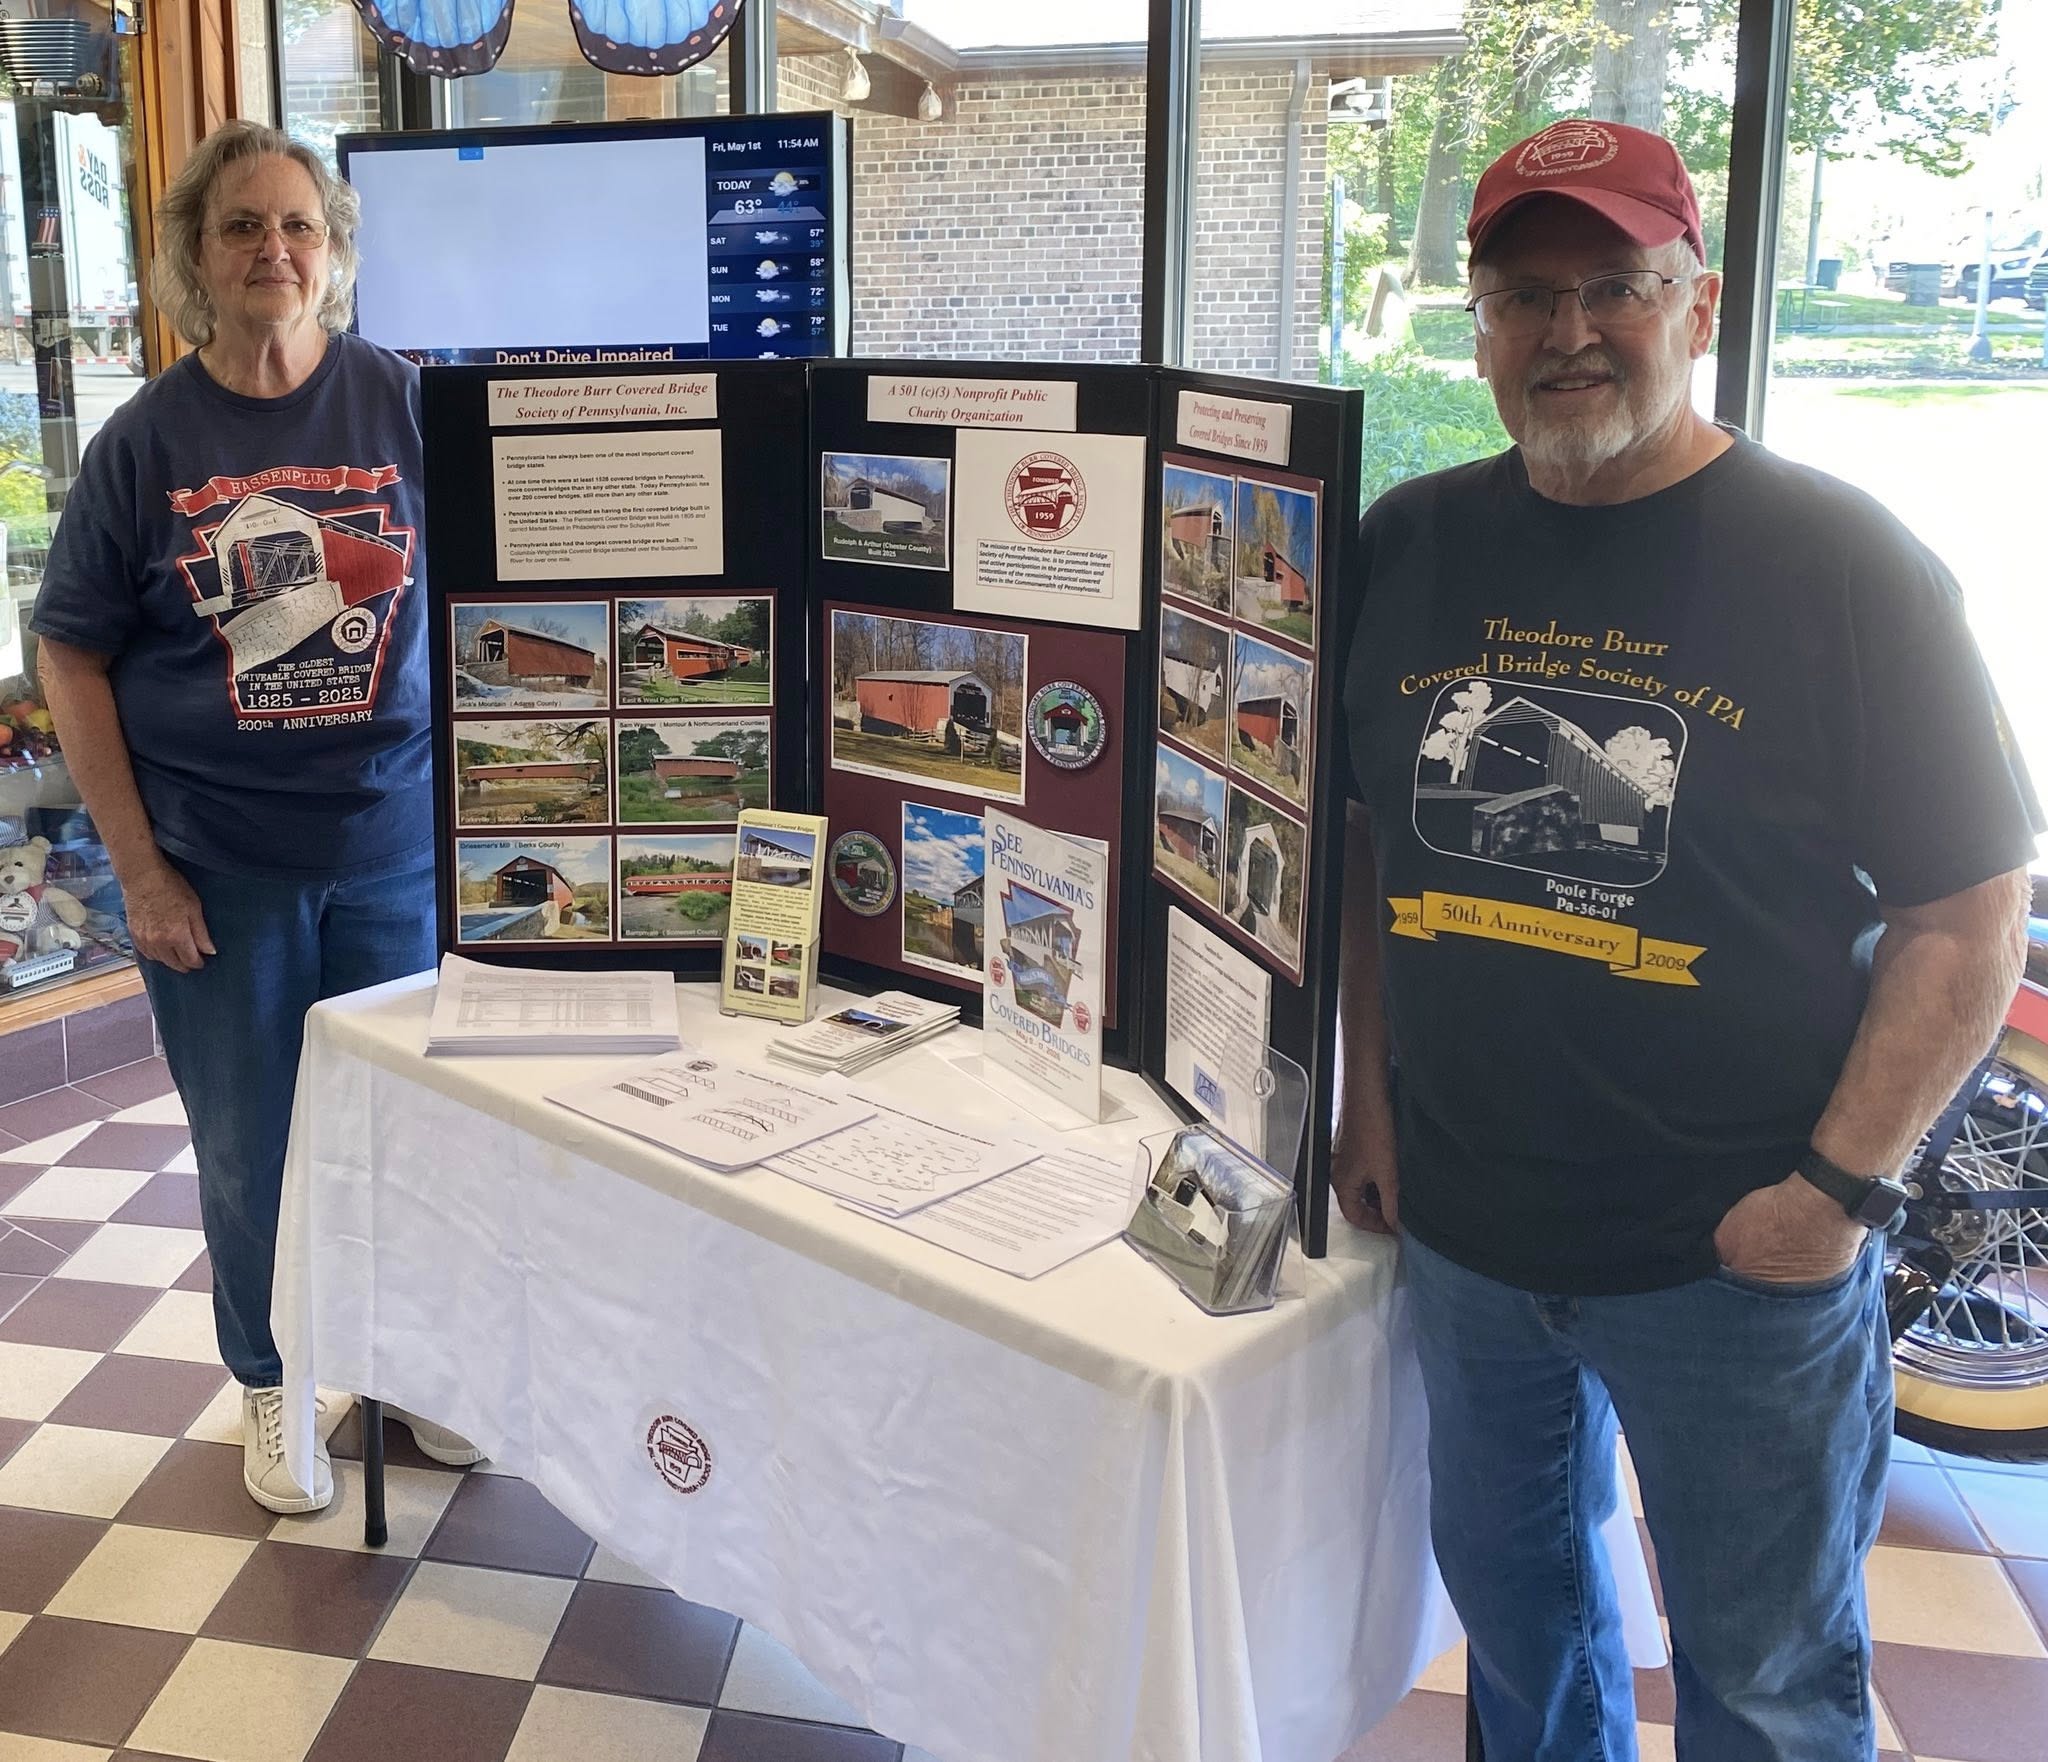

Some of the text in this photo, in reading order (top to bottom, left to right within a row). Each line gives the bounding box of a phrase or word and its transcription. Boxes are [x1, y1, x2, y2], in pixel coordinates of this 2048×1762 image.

[712, 141, 762, 152] Fri, May 1st
[778, 138, 819, 149] 11:54 AM
[716, 180, 752, 190] TODAY
[734, 199, 762, 214] 63°
[710, 237, 726, 245] SAT
[810, 228, 824, 237] 57°
[711, 266, 728, 274] SUN
[810, 288, 825, 296] 72°
[712, 324, 728, 332] TUE
[496, 348, 674, 364] Don't Drive Impaired
[496, 382, 708, 399] The Theodore Burr Covered Bridge
[888, 385, 1048, 402] A 501 (c)(3) Nonprofit Public
[516, 404, 688, 420] Society of Pennsylvania, Inc.
[908, 406, 1024, 423] Charity Organization
[1193, 402, 1267, 430] Protecting and Preserving
[1189, 424, 1268, 453] Covered Bridges Since 1959
[230, 470, 332, 494] HASSENPLUG
[1035, 512, 1054, 520] 1959
[908, 544, 932, 554] County)
[1484, 617, 1669, 657] Theodore Burr
[237, 664, 372, 683] DRIVEABLE COVERED BRIDGE
[277, 658, 334, 672] THE OLDEST
[250, 675, 360, 692] IN THE UNITED STATES
[1400, 652, 1748, 731] Covered Bridge Society of PA
[247, 694, 293, 709] 1825
[318, 686, 363, 704] 2025
[238, 710, 373, 731] 200th ANNIVERSARY
[995, 824, 1023, 855] SEE
[991, 839, 1094, 910] PENNSYLVANIA'S
[1546, 879, 1636, 908] Poole Forge
[1398, 908, 1418, 925] 1959
[1556, 896, 1618, 921] Pa-36-01
[1440, 902, 1620, 955] 50th Anniversary
[1644, 951, 1686, 972] 2009
[990, 994, 1040, 1038] COVERED
[1042, 1022, 1090, 1066] BRIDGES
